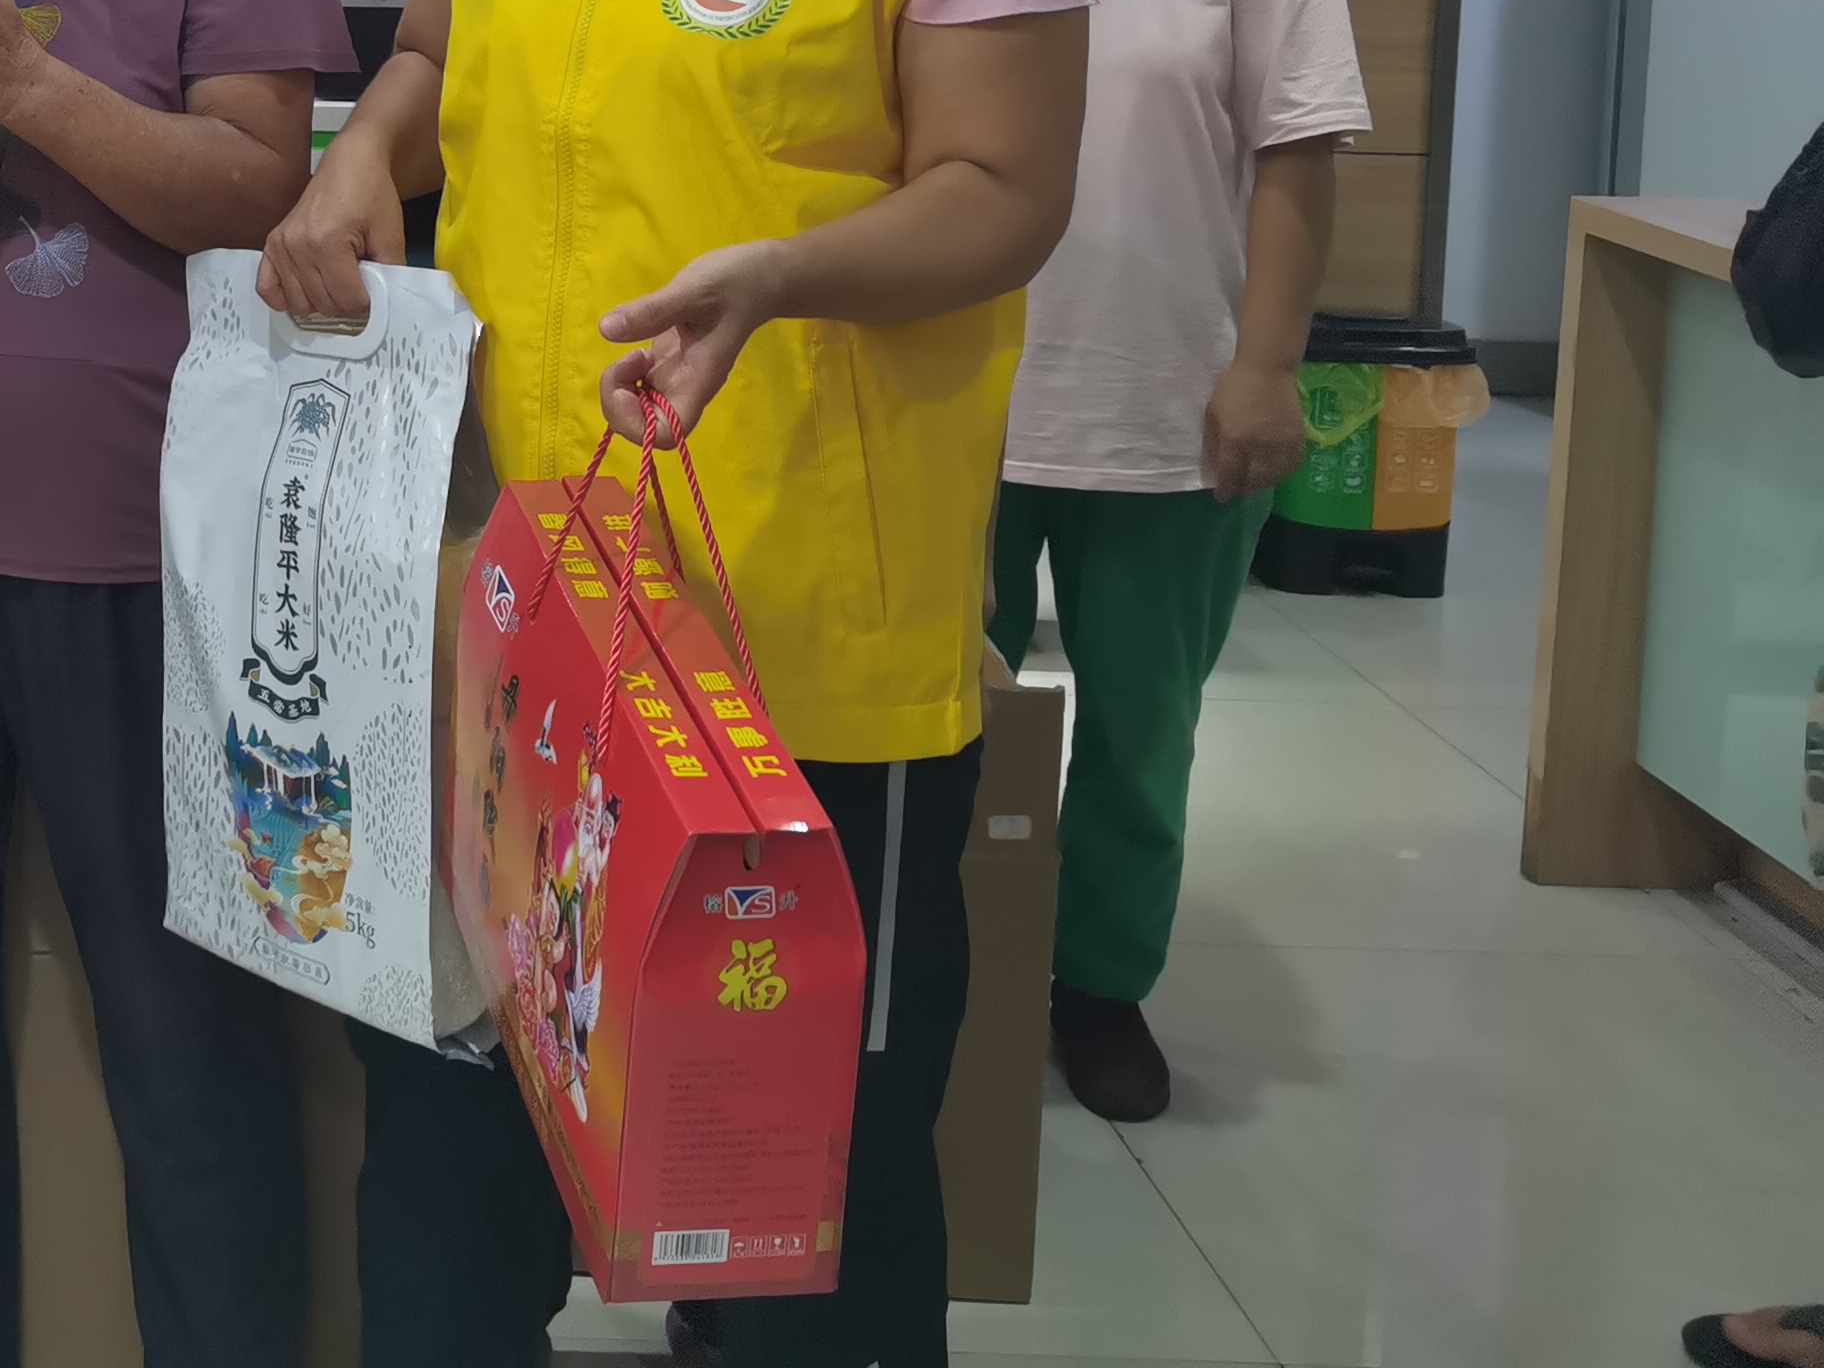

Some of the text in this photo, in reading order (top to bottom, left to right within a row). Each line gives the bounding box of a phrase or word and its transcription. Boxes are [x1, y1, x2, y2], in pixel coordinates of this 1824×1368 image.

[274, 475, 306, 652] 袁隆平大米
[619, 669, 709, 778] 大吉大利
[692, 670, 788, 778] 万事胜意
[344, 911, 376, 950] 5kg
[717, 938, 789, 1012] 福
